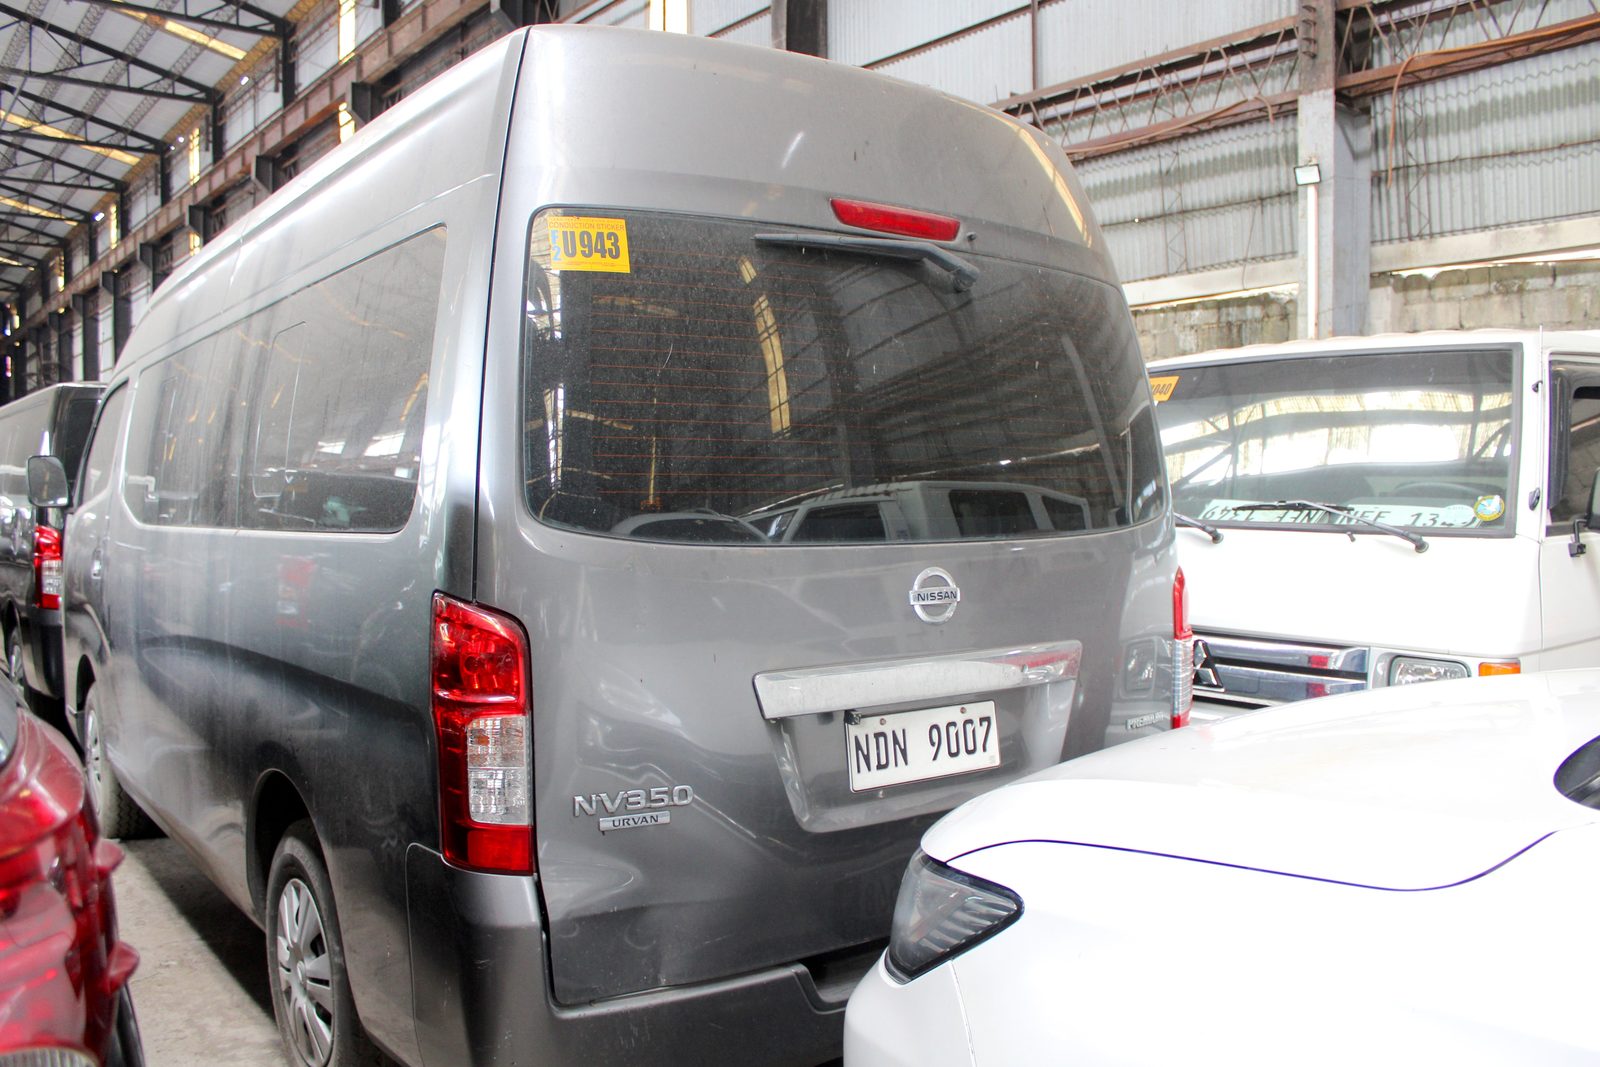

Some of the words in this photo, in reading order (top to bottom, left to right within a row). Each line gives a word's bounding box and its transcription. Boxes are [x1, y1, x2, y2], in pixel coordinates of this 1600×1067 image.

[548, 221, 595, 230] CONDUCTION
[596, 223, 625, 231] STICKER
[916, 590, 957, 602] NISSAN
[854, 728, 909, 774] NDN
[928, 716, 992, 762] 9007
[573, 784, 694, 817] NV350
[612, 814, 659, 828] URVAN
